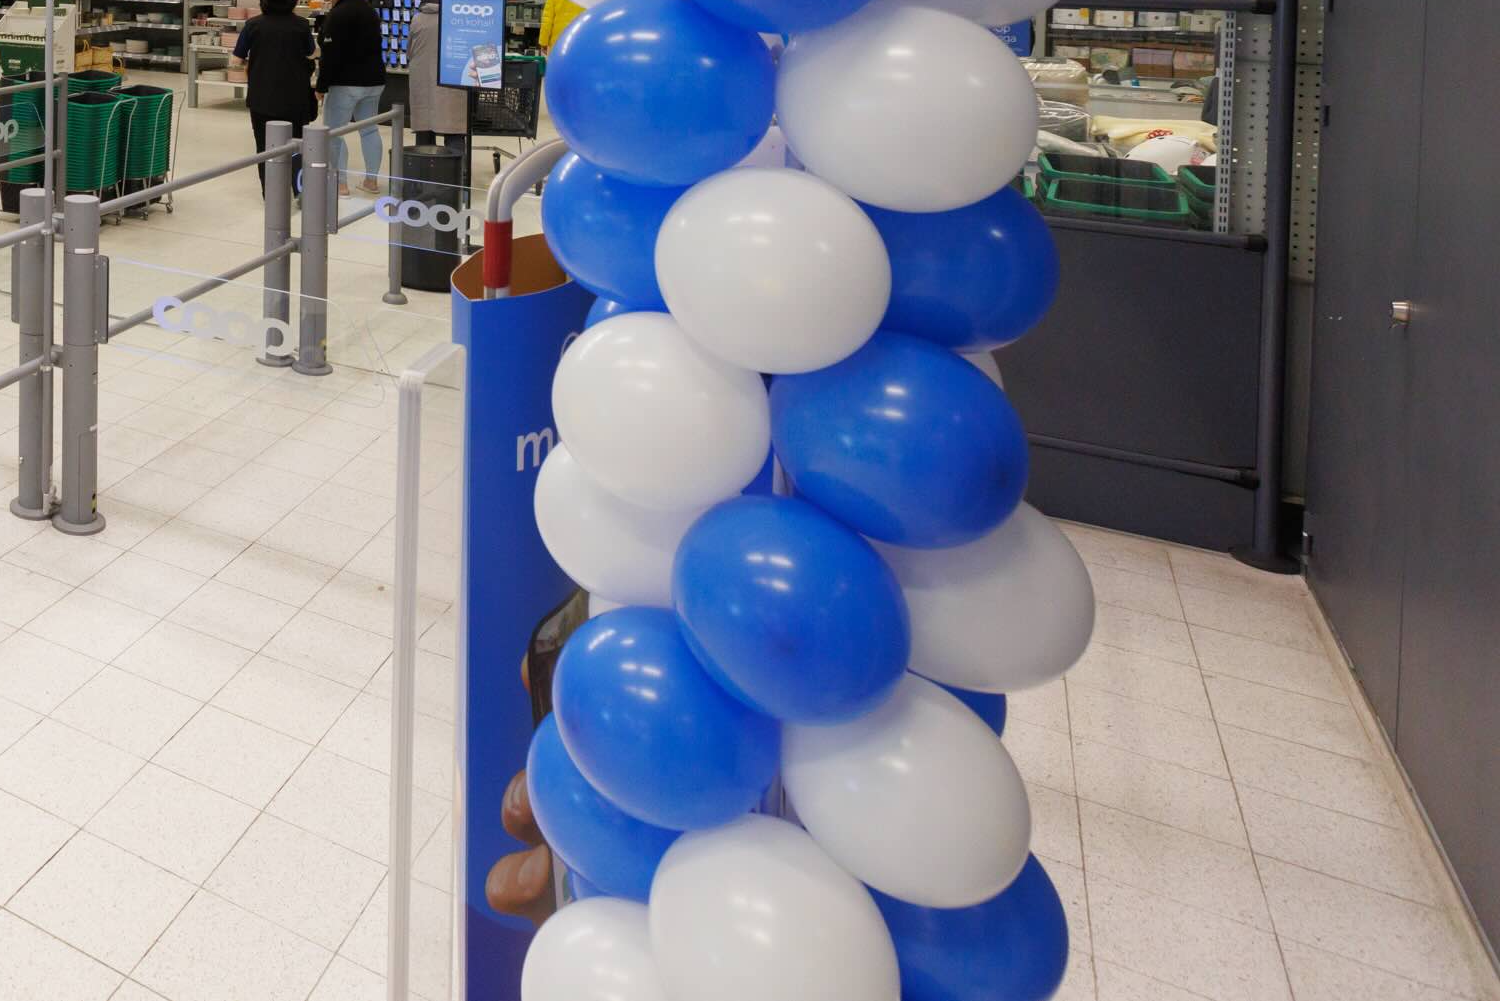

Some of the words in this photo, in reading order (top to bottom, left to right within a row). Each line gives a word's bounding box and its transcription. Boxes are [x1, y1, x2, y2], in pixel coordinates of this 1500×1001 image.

[451, 3, 494, 19] coop
[375, 196, 486, 240] coop
[152, 295, 295, 361] coop
